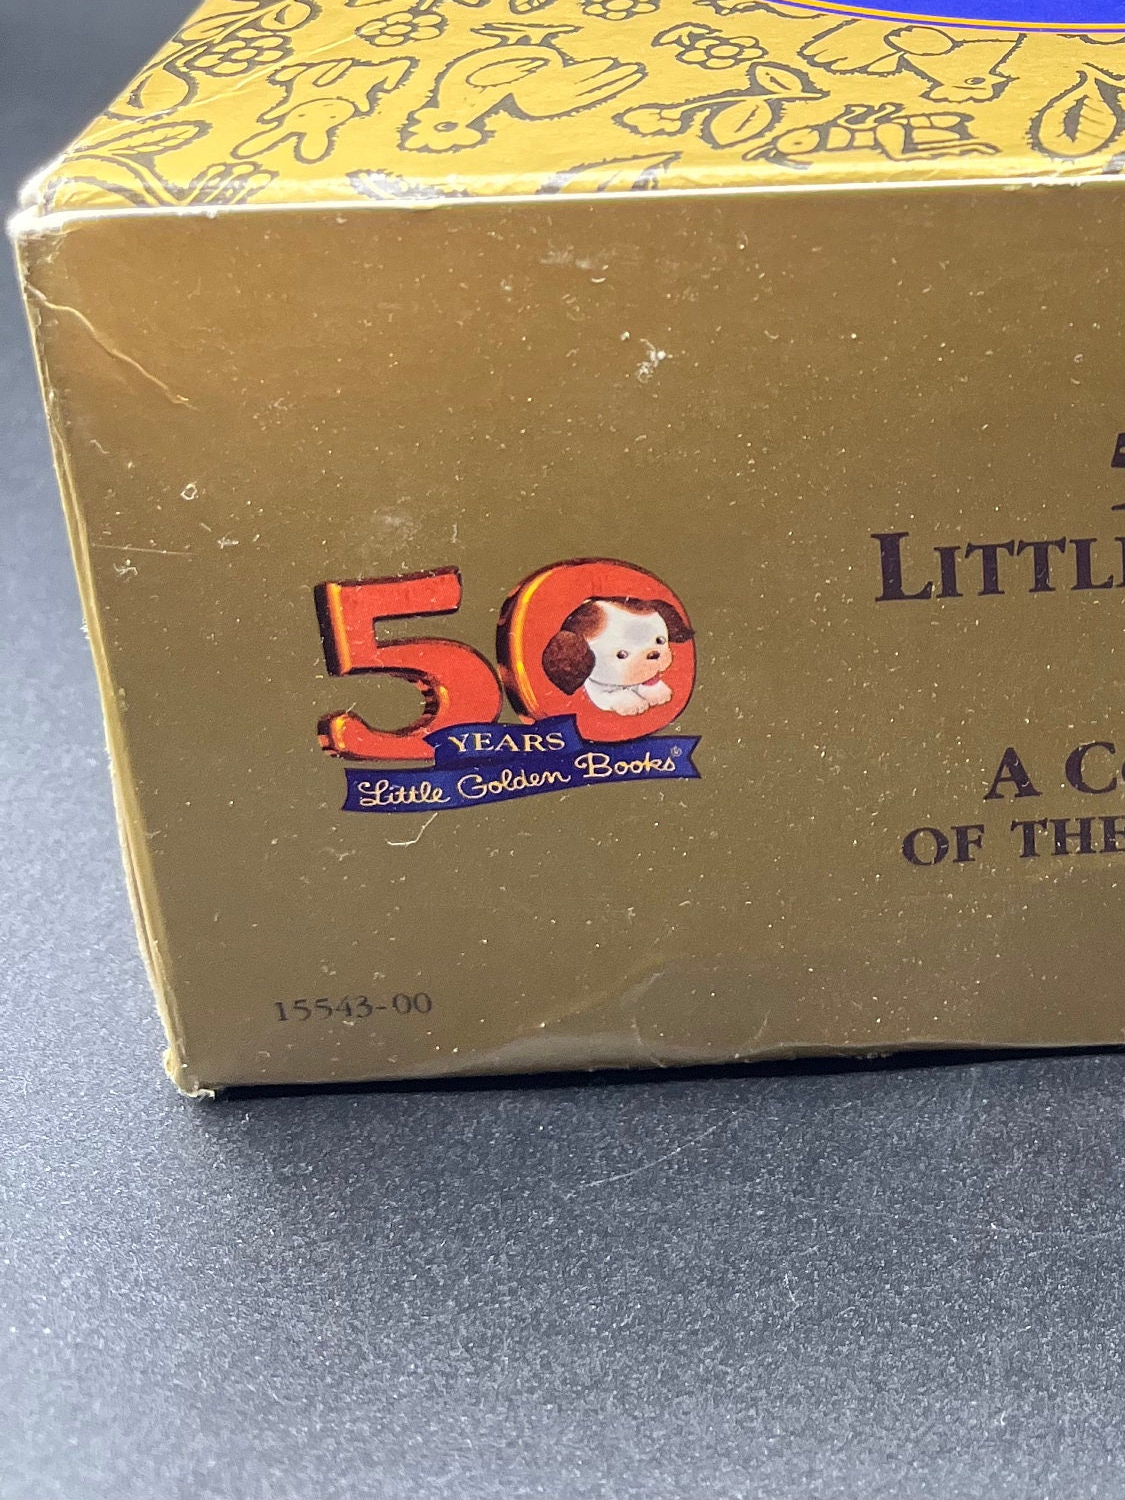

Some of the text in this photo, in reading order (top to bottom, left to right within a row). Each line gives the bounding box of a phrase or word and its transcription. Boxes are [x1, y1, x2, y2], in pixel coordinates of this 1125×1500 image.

[314, 557, 696, 761] 50
[447, 732, 566, 753] YEARS
[357, 780, 450, 808] Little
[456, 768, 572, 799] Golden
[983, 746, 1040, 801] A
[901, 825, 986, 867] OF
[274, 992, 433, 1022] 15543-00
